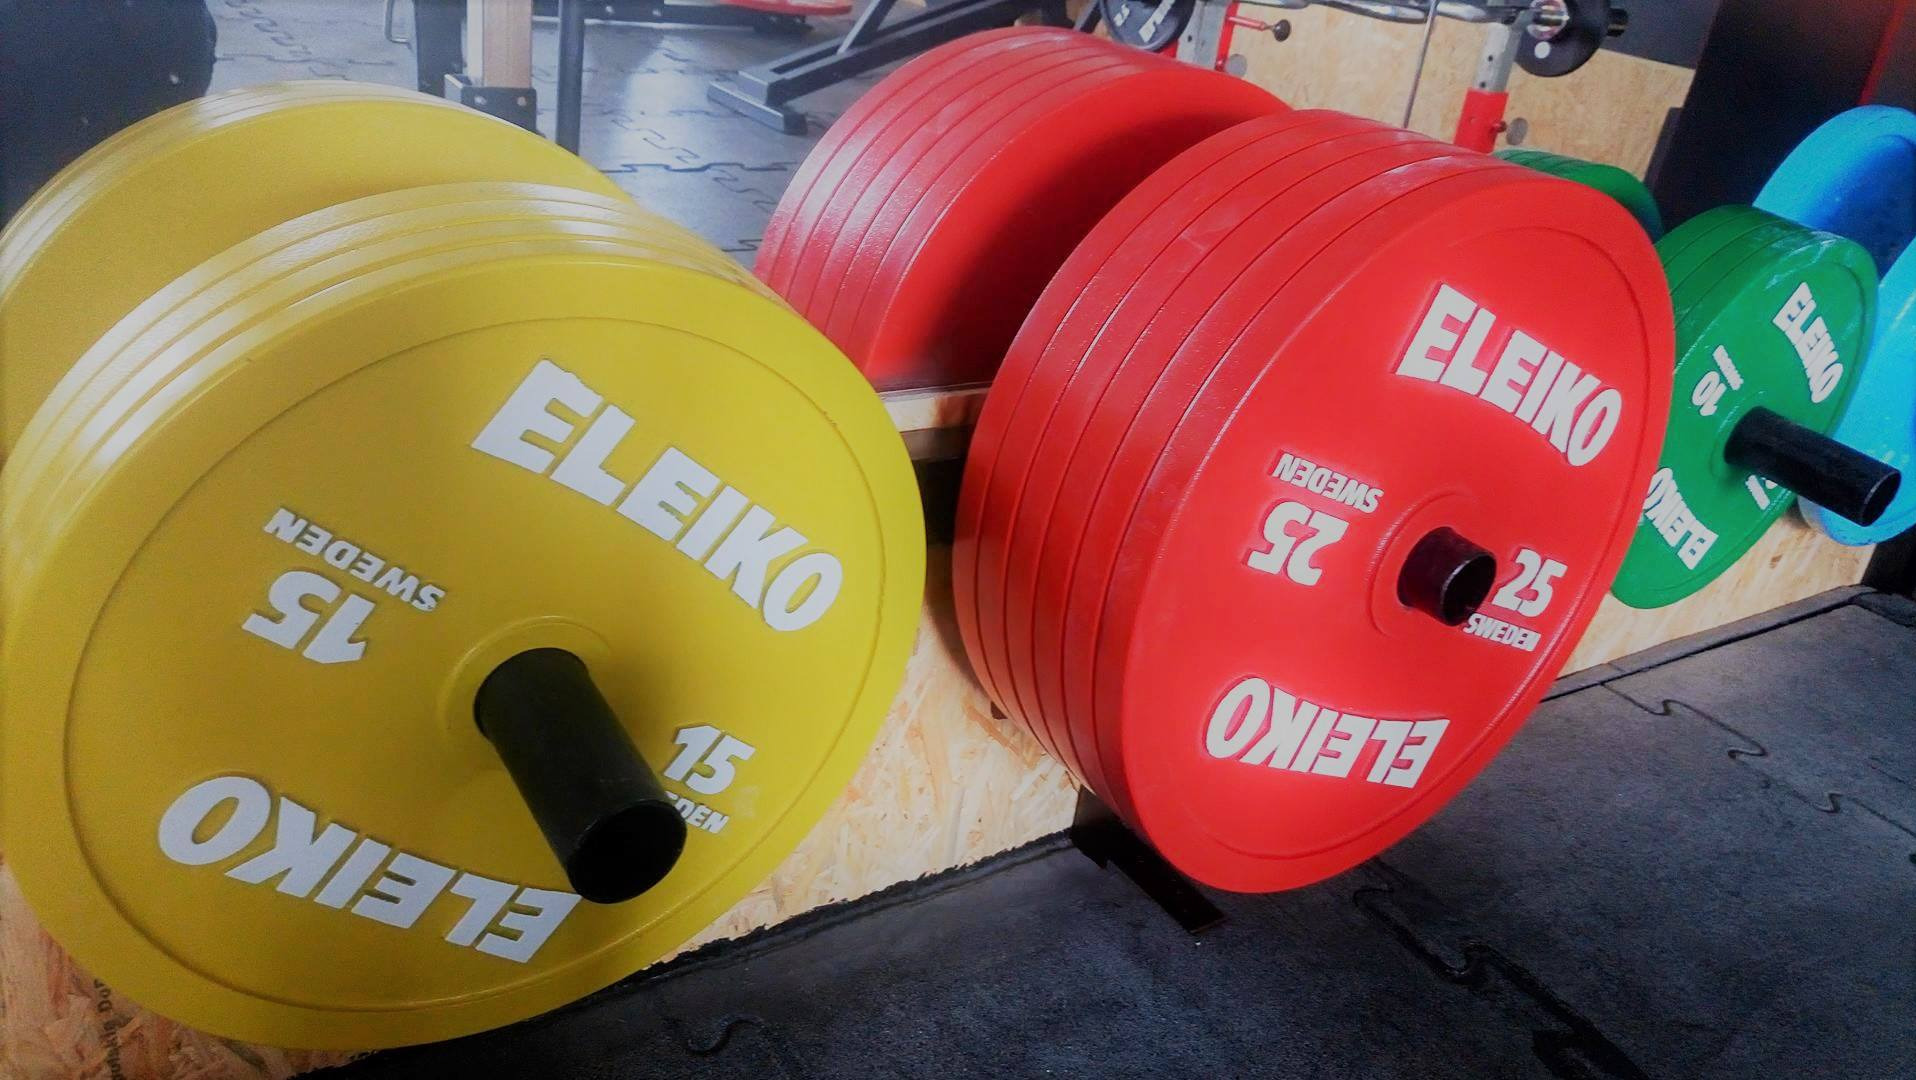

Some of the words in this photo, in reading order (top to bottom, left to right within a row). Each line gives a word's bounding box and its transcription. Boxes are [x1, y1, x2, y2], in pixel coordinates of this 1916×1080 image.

[1394, 283, 1622, 467] ELEIKO
[1772, 281, 1844, 404] ELEIKO
[1692, 371, 1727, 416] 10
[470, 358, 843, 632] ELEIKO
[1271, 452, 1384, 514] SWEDEN
[263, 507, 446, 612] SWEDEN
[1247, 501, 1350, 586] 25
[1491, 548, 1568, 618] 25
[241, 571, 376, 664] 15
[1463, 612, 1541, 652] SWEDEN
[663, 725, 756, 794] 15
[1205, 677, 1450, 788] ELEIKO
[158, 776, 583, 964] ELEIKO
